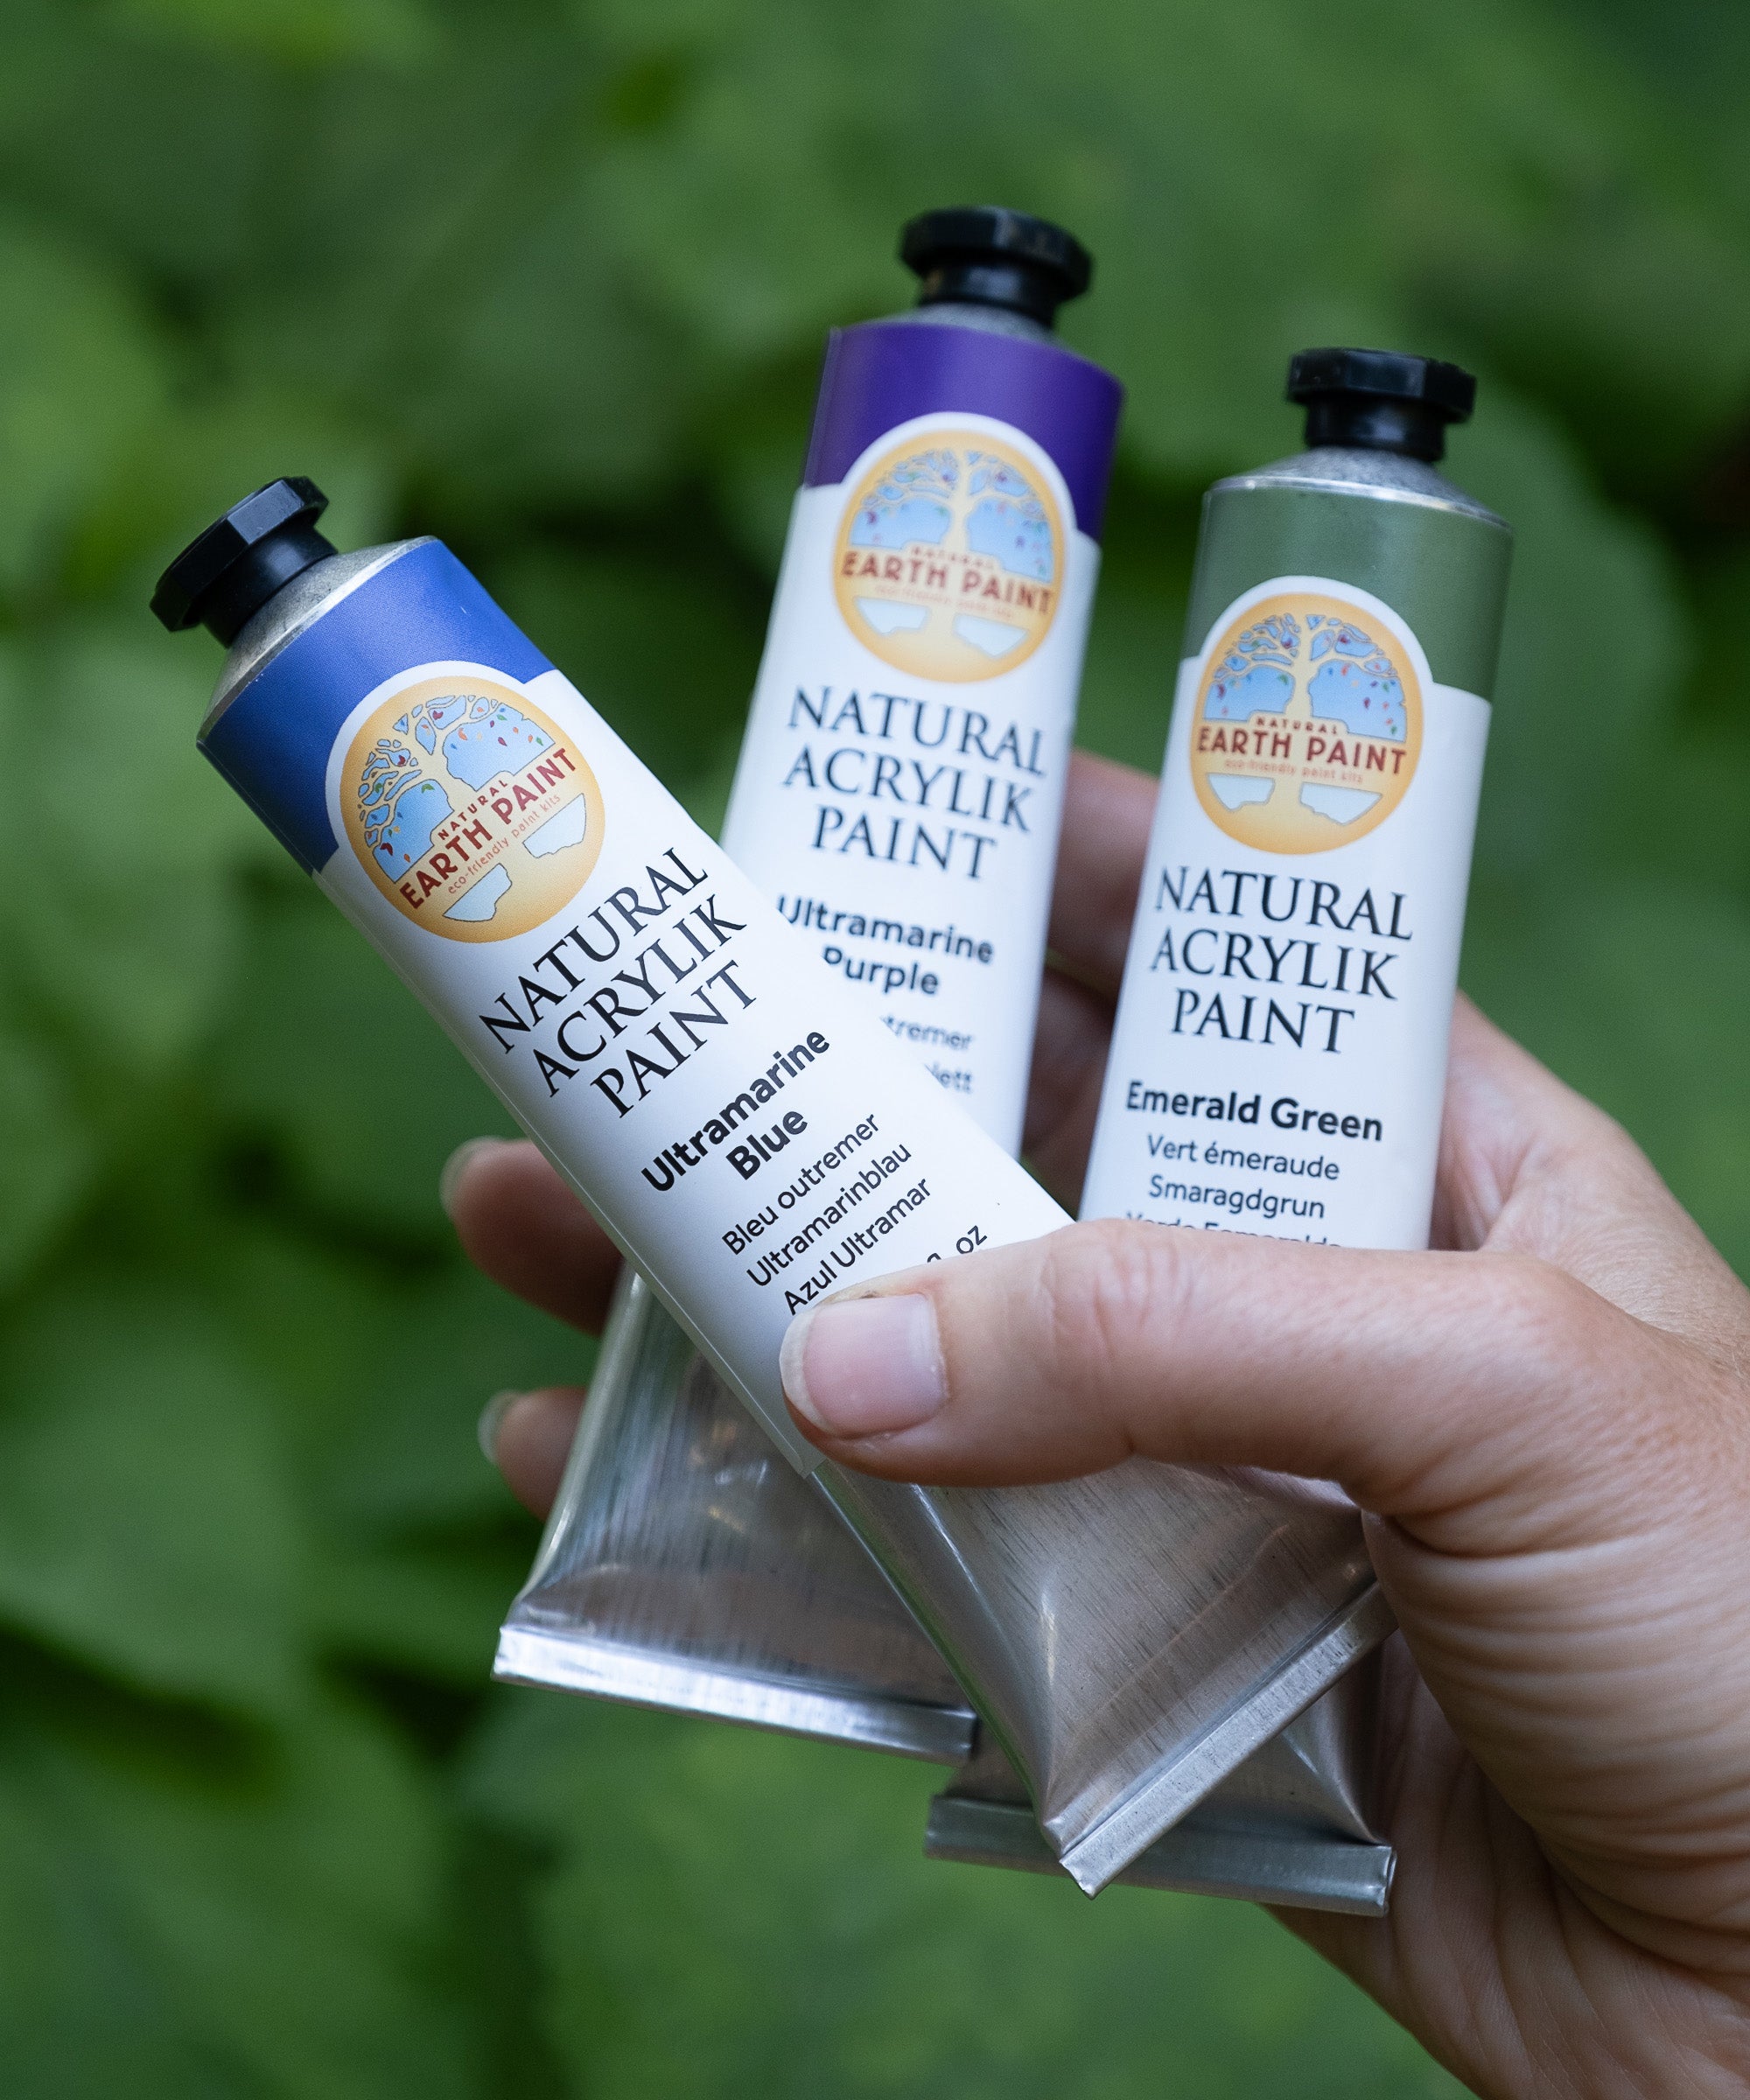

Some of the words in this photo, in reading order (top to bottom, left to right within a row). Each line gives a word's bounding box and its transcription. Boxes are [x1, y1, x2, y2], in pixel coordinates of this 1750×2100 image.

[842, 551, 947, 589] EARTH
[962, 570, 1054, 615] PAINT
[788, 686, 1045, 777] NATURAL
[1197, 726, 1292, 759] EARTH
[1306, 736, 1407, 774] PAINT
[1256, 717, 1338, 735] NATURAL
[438, 780, 508, 840] NATURAL
[782, 745, 1032, 833] ACRYLIK
[399, 819, 493, 909] EARTH
[491, 747, 578, 825] PAINT
[448, 837, 509, 893] eco-friendly
[511, 810, 540, 838] paint
[540, 794, 561, 812] kits
[812, 804, 997, 879] PAINT
[777, 894, 994, 963] Ultramarine
[1155, 865, 1413, 941] NATURAL
[479, 847, 708, 1054] NATURAL
[822, 945, 939, 994] Purple
[1150, 926, 1398, 1001] ACRYLIK
[533, 893, 747, 1097] ACRYLIK
[1172, 987, 1355, 1054] PAINT
[590, 960, 757, 1118] PAINT
[641, 1032, 830, 1192] Ultramarine
[725, 1110, 808, 1180] Blue
[1126, 1080, 1261, 1124] Emerald
[1270, 1097, 1382, 1141] Green
[722, 1205, 779, 1255] Bleu
[777, 1114, 878, 1209] outremer
[1148, 1134, 1197, 1163] Vert
[1204, 1141, 1340, 1180] émeraude
[746, 1144, 912, 1286] Ultramarinblau
[1148, 1174, 1325, 1219] Smaragdgrun
[783, 1264, 837, 1315] Azul
[830, 1178, 931, 1268] Ultramar
[956, 1225, 988, 1254] oz
